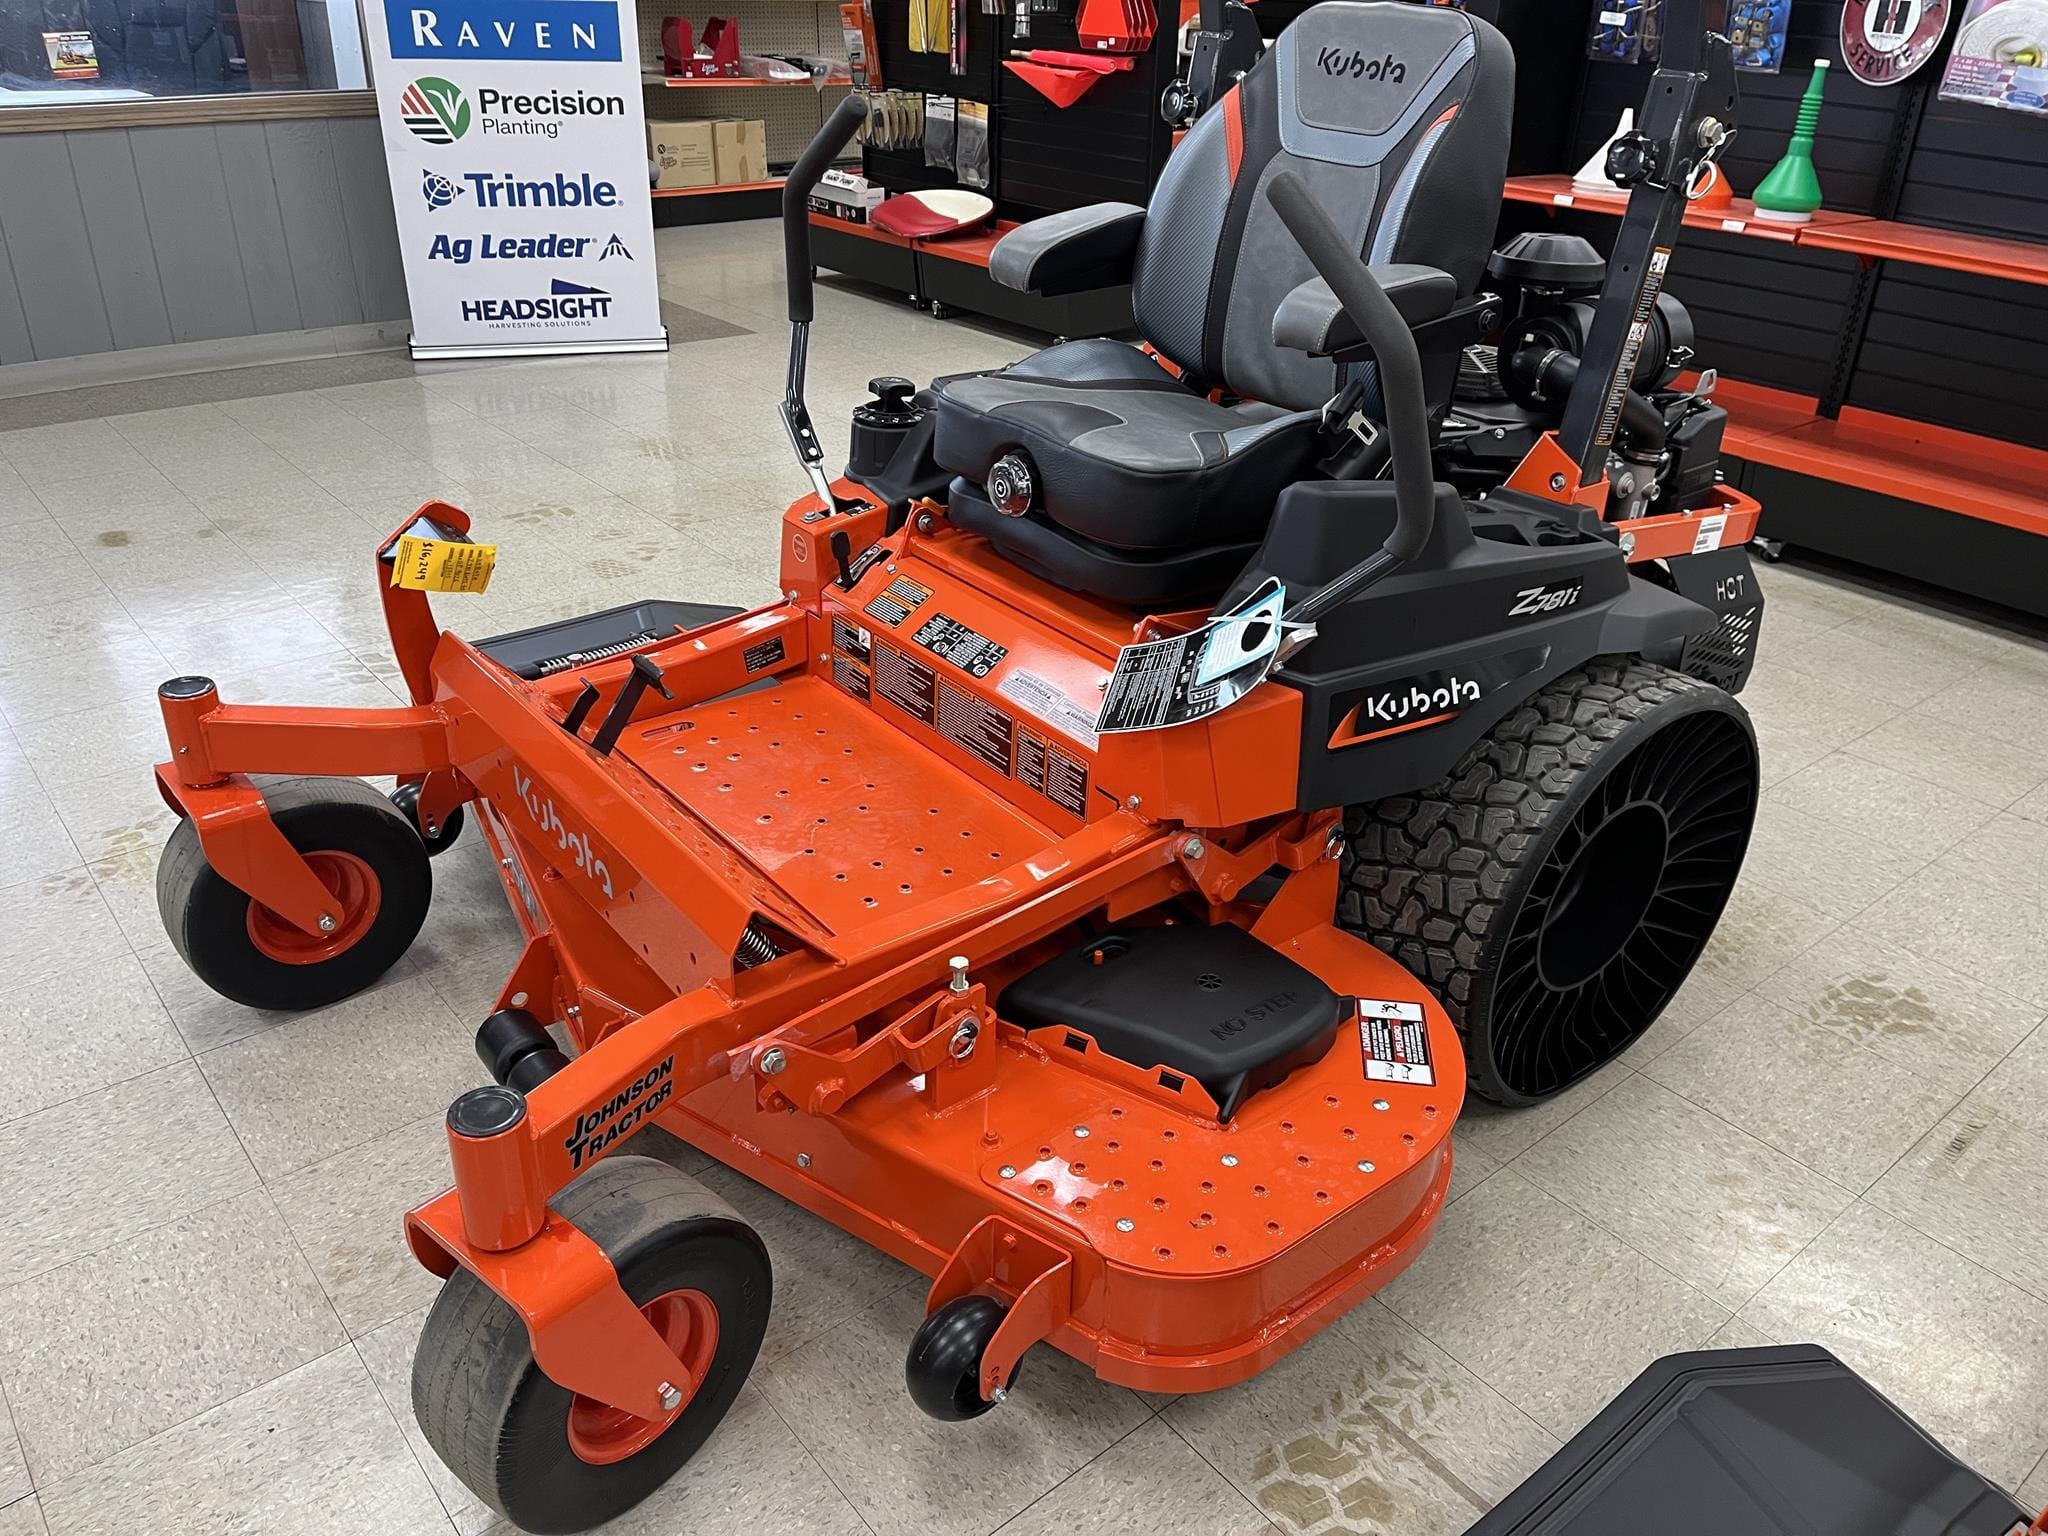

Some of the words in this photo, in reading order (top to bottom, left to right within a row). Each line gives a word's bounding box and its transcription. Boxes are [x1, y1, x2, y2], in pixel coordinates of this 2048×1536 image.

[411, 9, 596, 49] RAVEN
[1317, 47, 1406, 84] Kubota
[1850, 42, 1914, 77] SERVICE
[479, 88, 624, 116] Precision
[483, 119, 559, 138] Planting
[464, 173, 617, 208] Trimble
[428, 234, 472, 264] Ag
[481, 233, 591, 259] Leader
[461, 297, 612, 321] HEADSIGHT
[489, 322, 542, 330] HARVESTING
[545, 320, 591, 328] SOLUTIONS
[415, 541, 434, 581] $16,249
[1508, 584, 1582, 617] Z781i
[1367, 676, 1481, 721] Kubota
[514, 765, 613, 899] Kubota
[1209, 1018, 1247, 1041] NO
[1361, 1021, 1371, 1047] DANGER
[1394, 1025, 1405, 1052] PELIGRO
[565, 1055, 674, 1150] JOHNSON
[568, 1079, 673, 1171] TRACTOR
